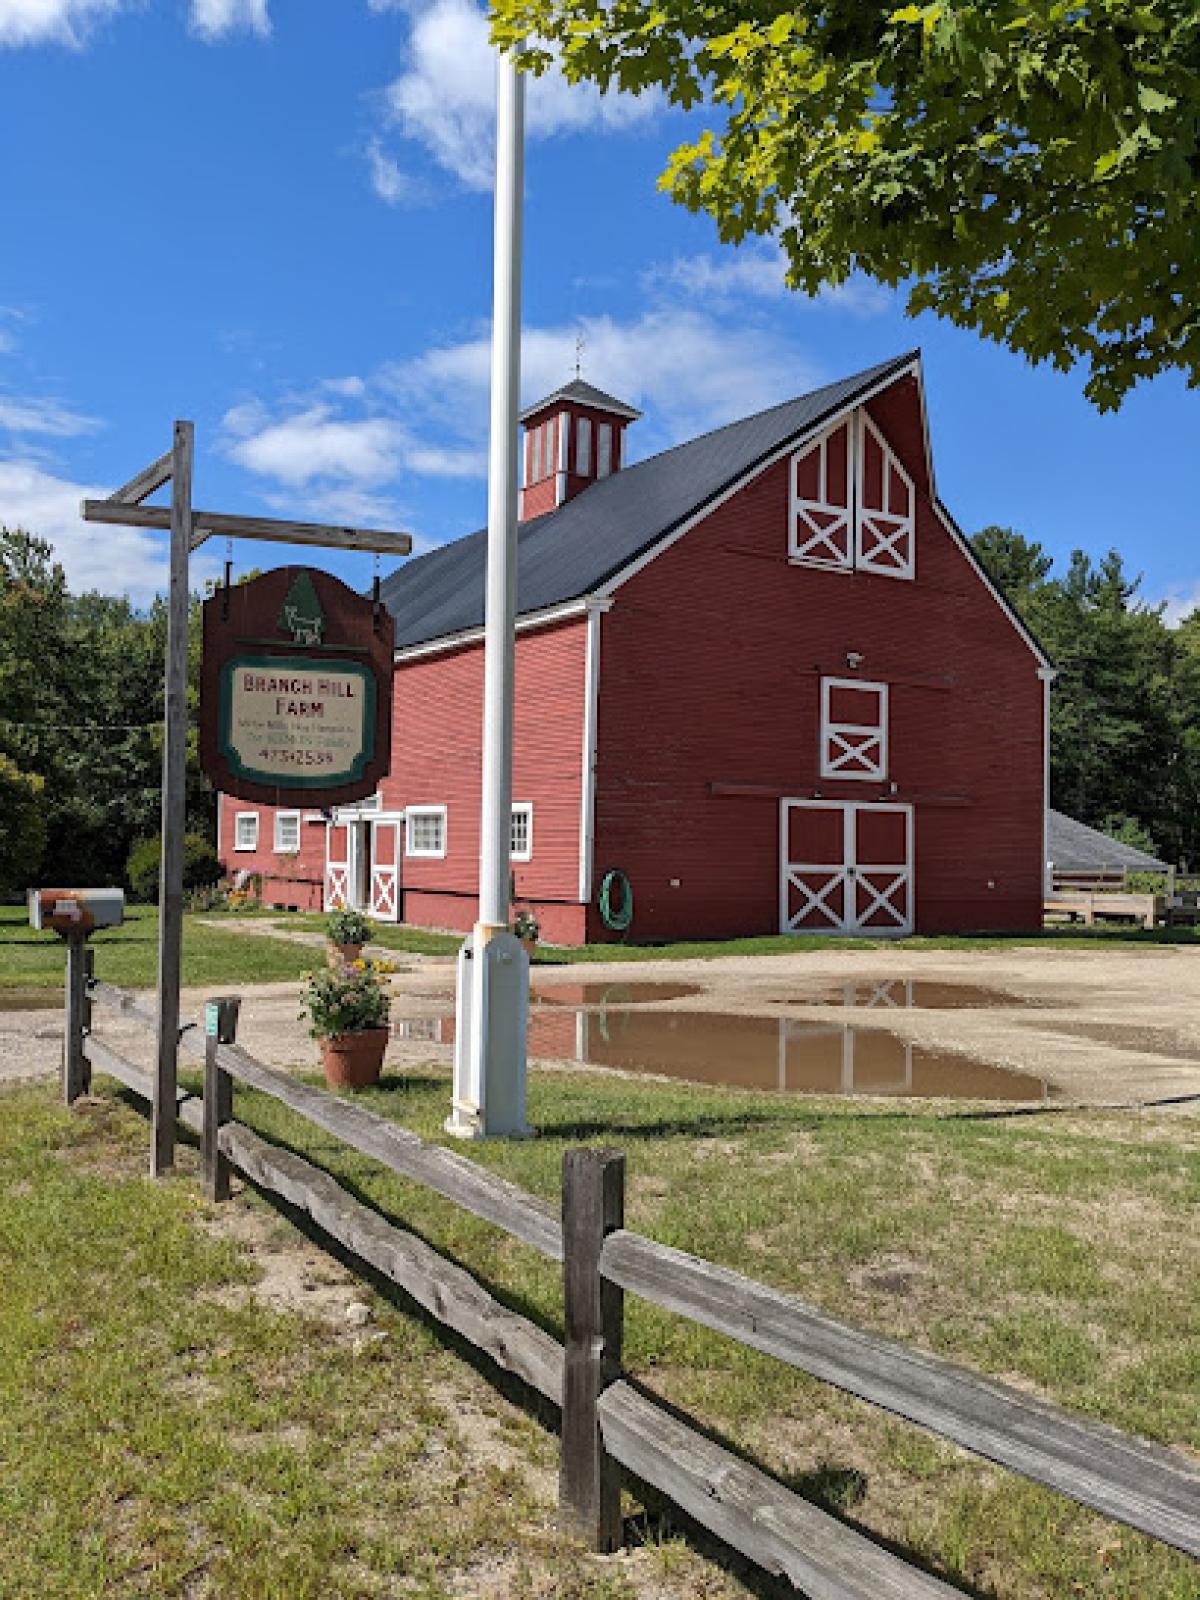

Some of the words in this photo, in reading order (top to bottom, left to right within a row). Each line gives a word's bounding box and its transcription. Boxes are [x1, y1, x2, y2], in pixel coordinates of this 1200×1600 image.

[243, 673, 313, 695] BRANCH
[317, 678, 355, 698] HILL
[275, 697, 324, 718] FARM
